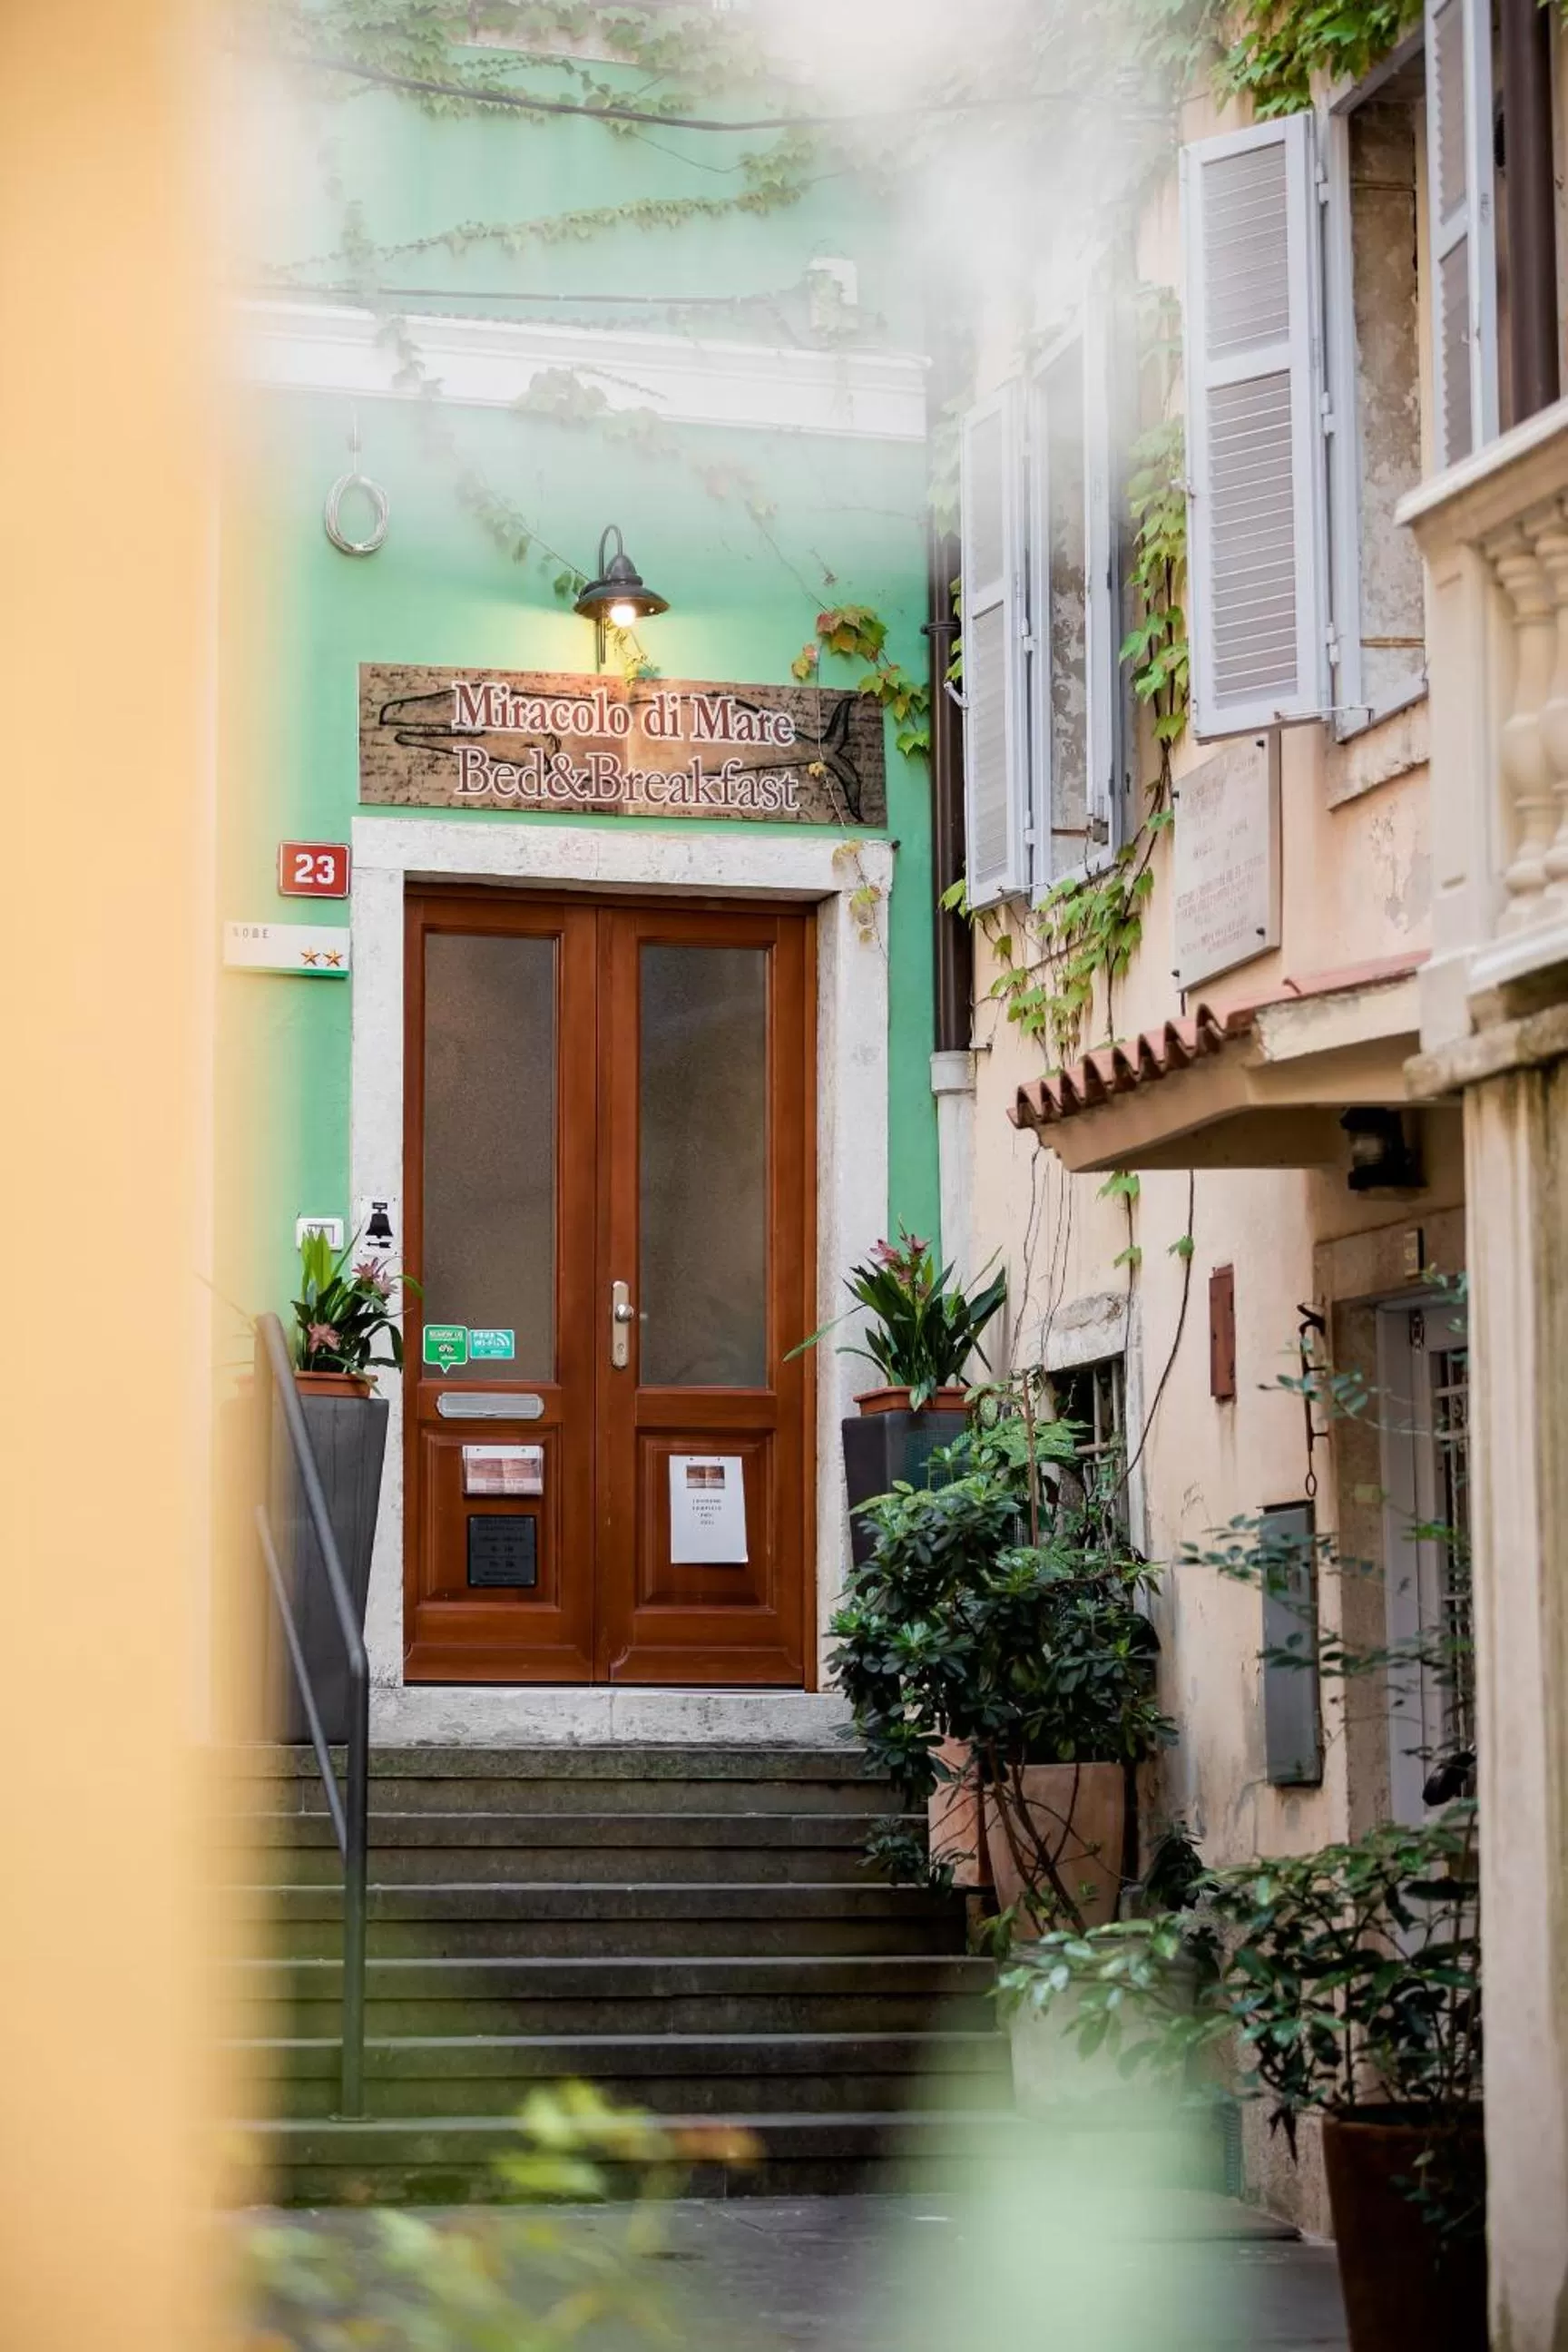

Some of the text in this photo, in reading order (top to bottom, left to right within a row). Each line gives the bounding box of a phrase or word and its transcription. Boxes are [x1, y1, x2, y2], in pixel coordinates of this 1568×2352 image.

[451, 681, 795, 747] Miracolo di Mare
[454, 746, 800, 810] Bed&Breakfast
[294, 853, 335, 885] 23
